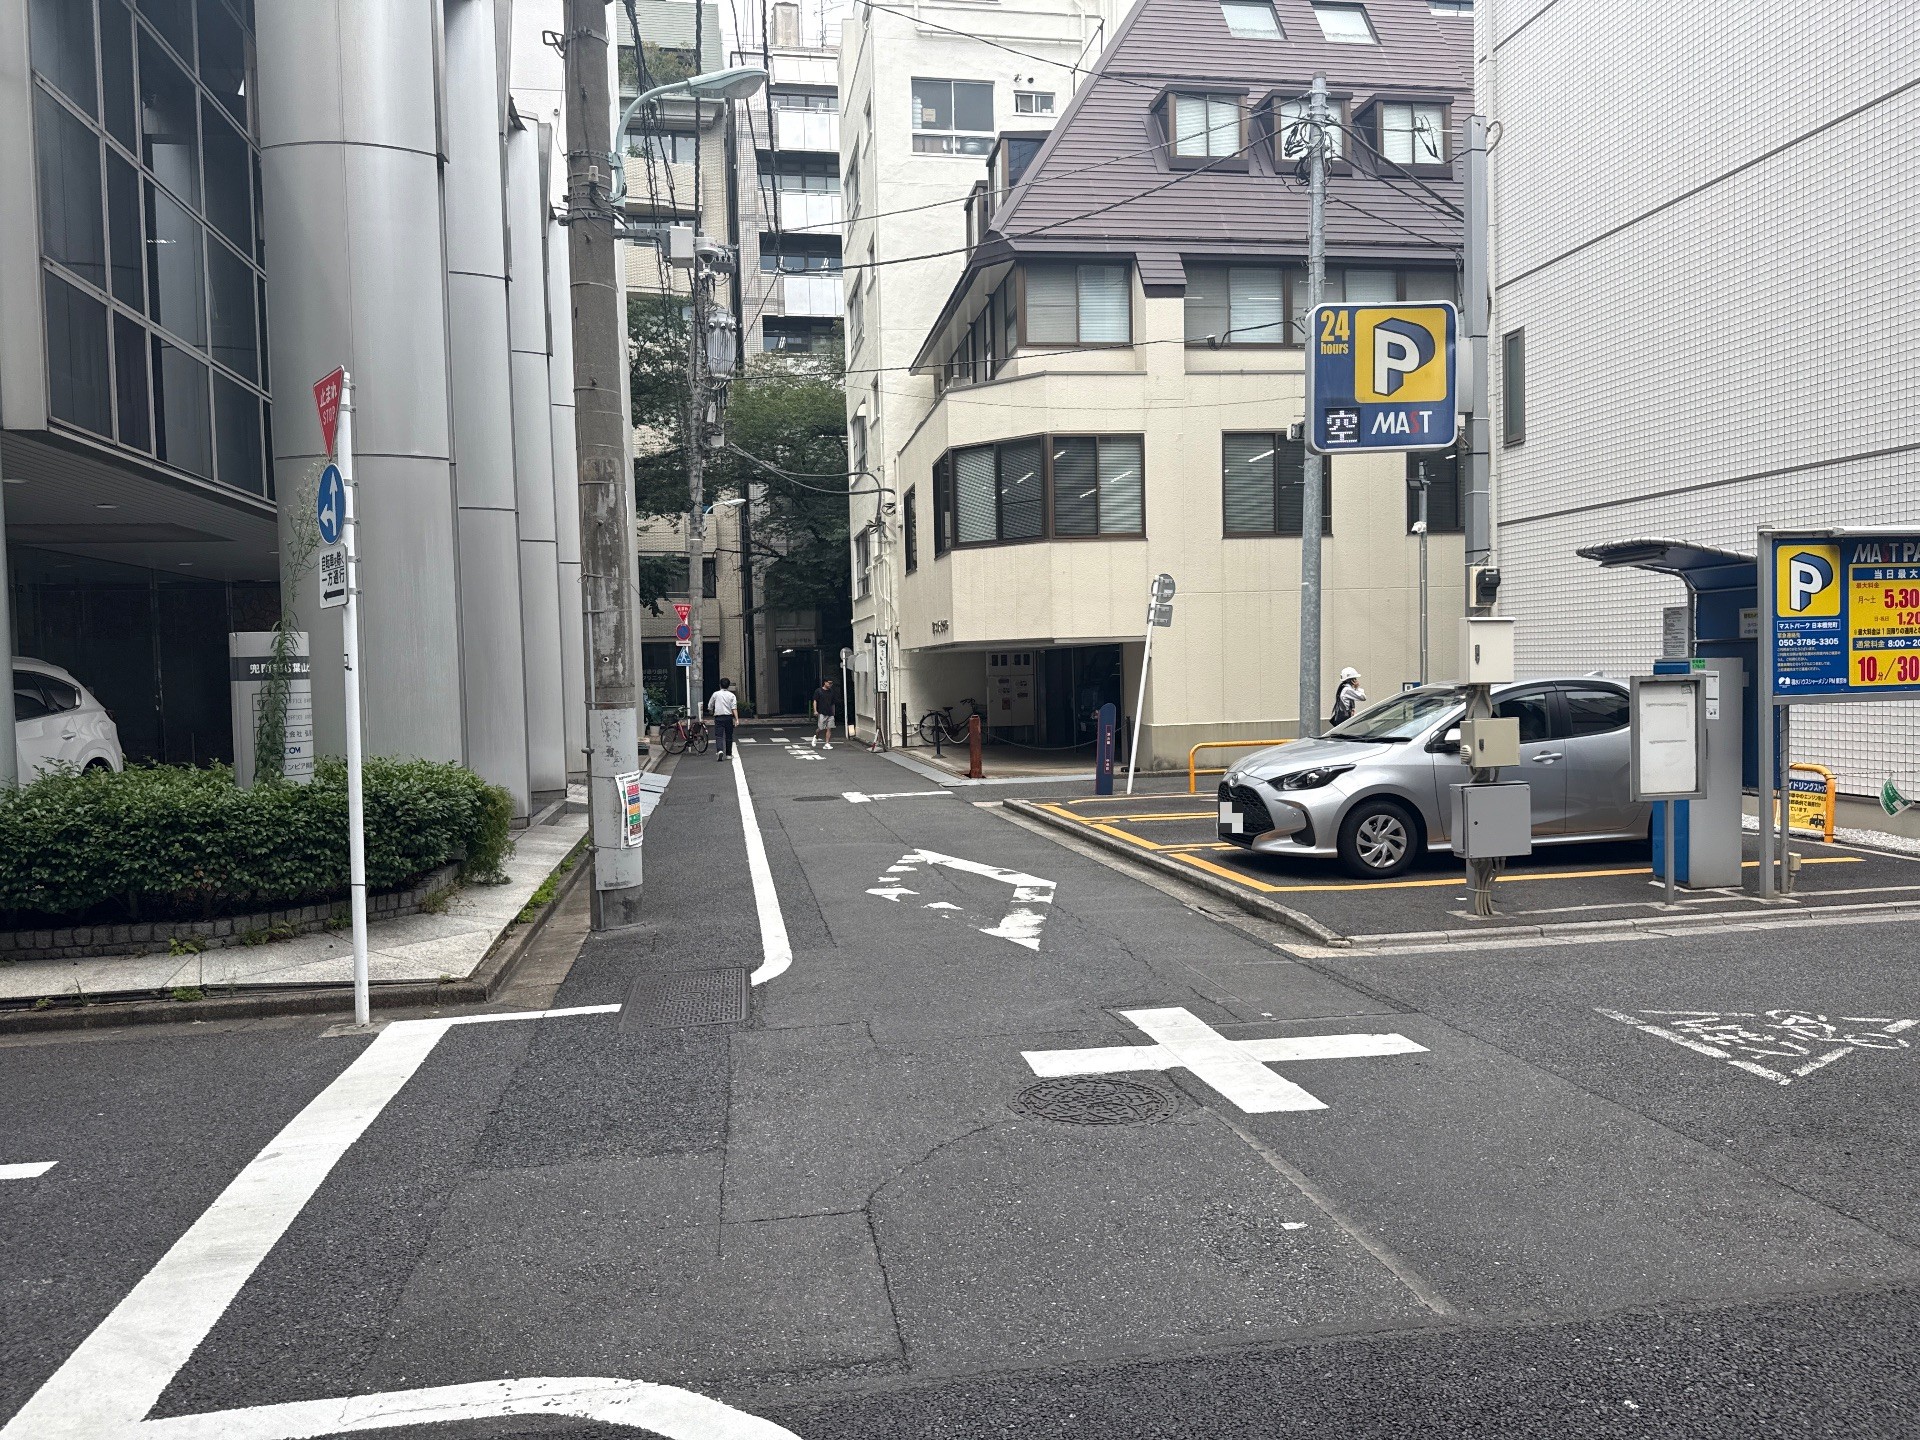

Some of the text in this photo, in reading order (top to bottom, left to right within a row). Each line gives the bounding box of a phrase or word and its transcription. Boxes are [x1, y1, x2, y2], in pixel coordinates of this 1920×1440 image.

[1320, 310, 1350, 342] 24
[1320, 342, 1349, 355] hours
[319, 384, 338, 408] 止まれ
[322, 408, 336, 426] STOP
[1371, 411, 1432, 435] MAST
[1326, 410, 1358, 444] 空
[321, 568, 345, 587] 一方通行
[1874, 569, 1919, 580] 当日最大
[1855, 639, 1885, 649] 通常料金
